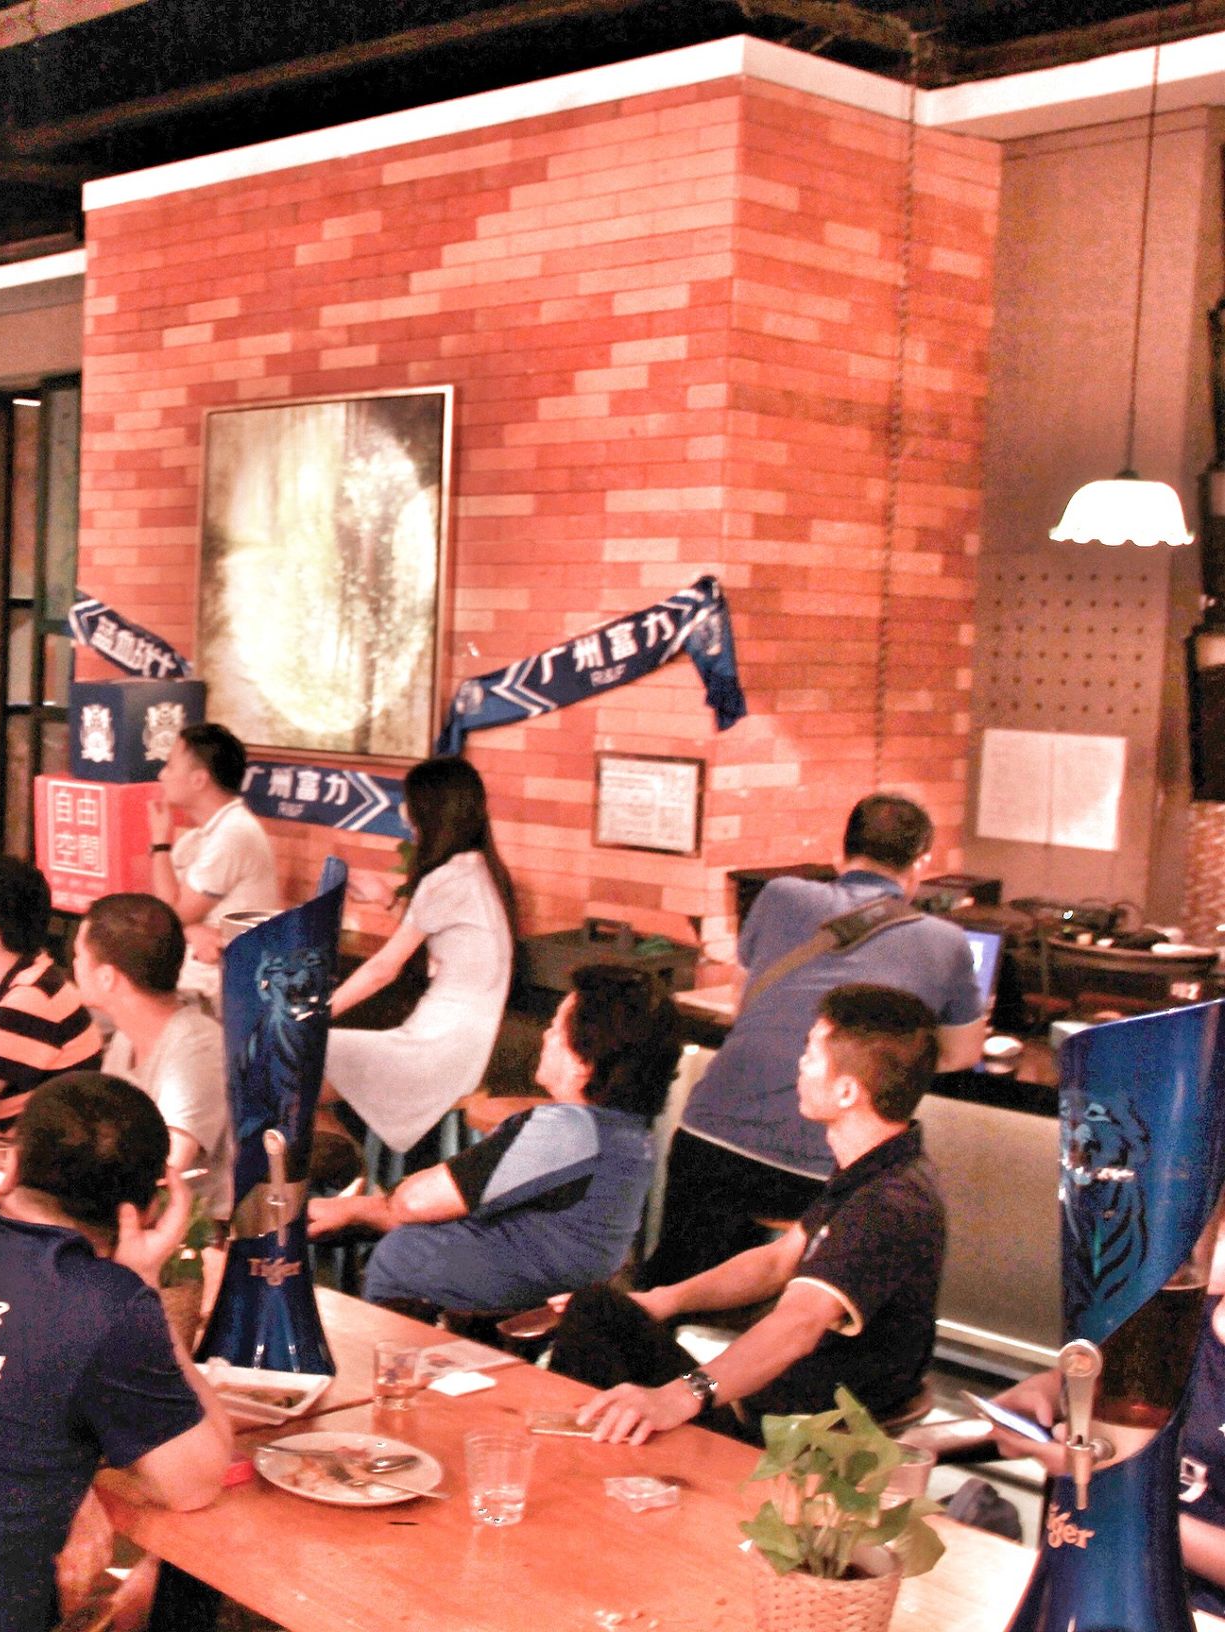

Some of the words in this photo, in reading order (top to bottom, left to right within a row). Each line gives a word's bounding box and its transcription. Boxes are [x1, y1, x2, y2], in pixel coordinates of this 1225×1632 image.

[539, 610, 676, 685] 广州富力
[240, 766, 350, 806] 广州富力
[55, 787, 98, 826] 自由
[247, 1256, 303, 1287] Tiger
